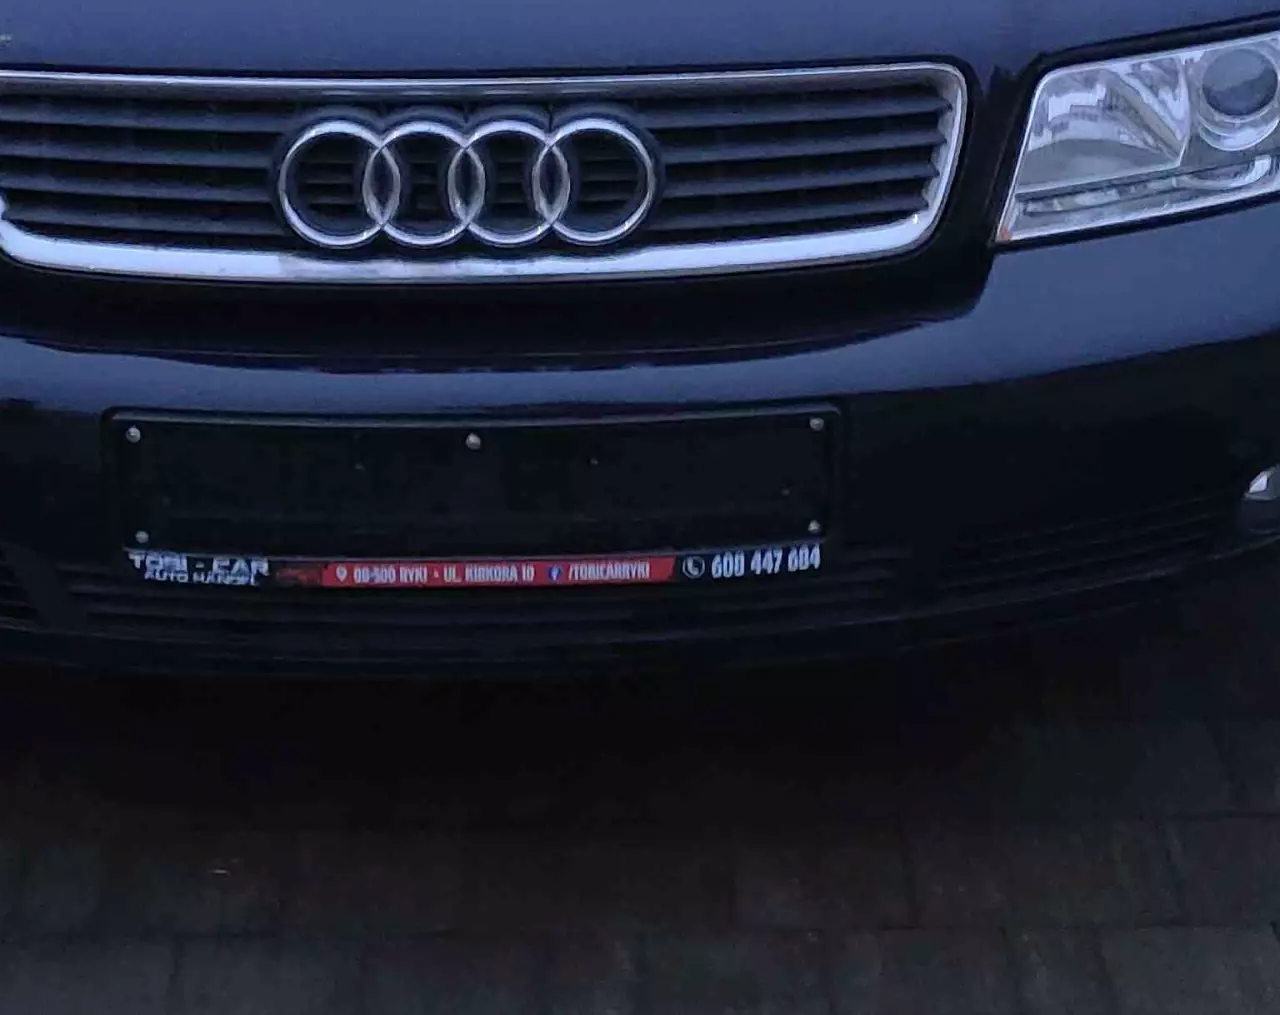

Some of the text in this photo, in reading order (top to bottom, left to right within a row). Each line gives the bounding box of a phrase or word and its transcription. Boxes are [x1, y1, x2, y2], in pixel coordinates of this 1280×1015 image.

[212, 557, 269, 576] CAR
[711, 550, 745, 579] 600
[750, 547, 783, 575] 447
[144, 568, 189, 583] AUTO
